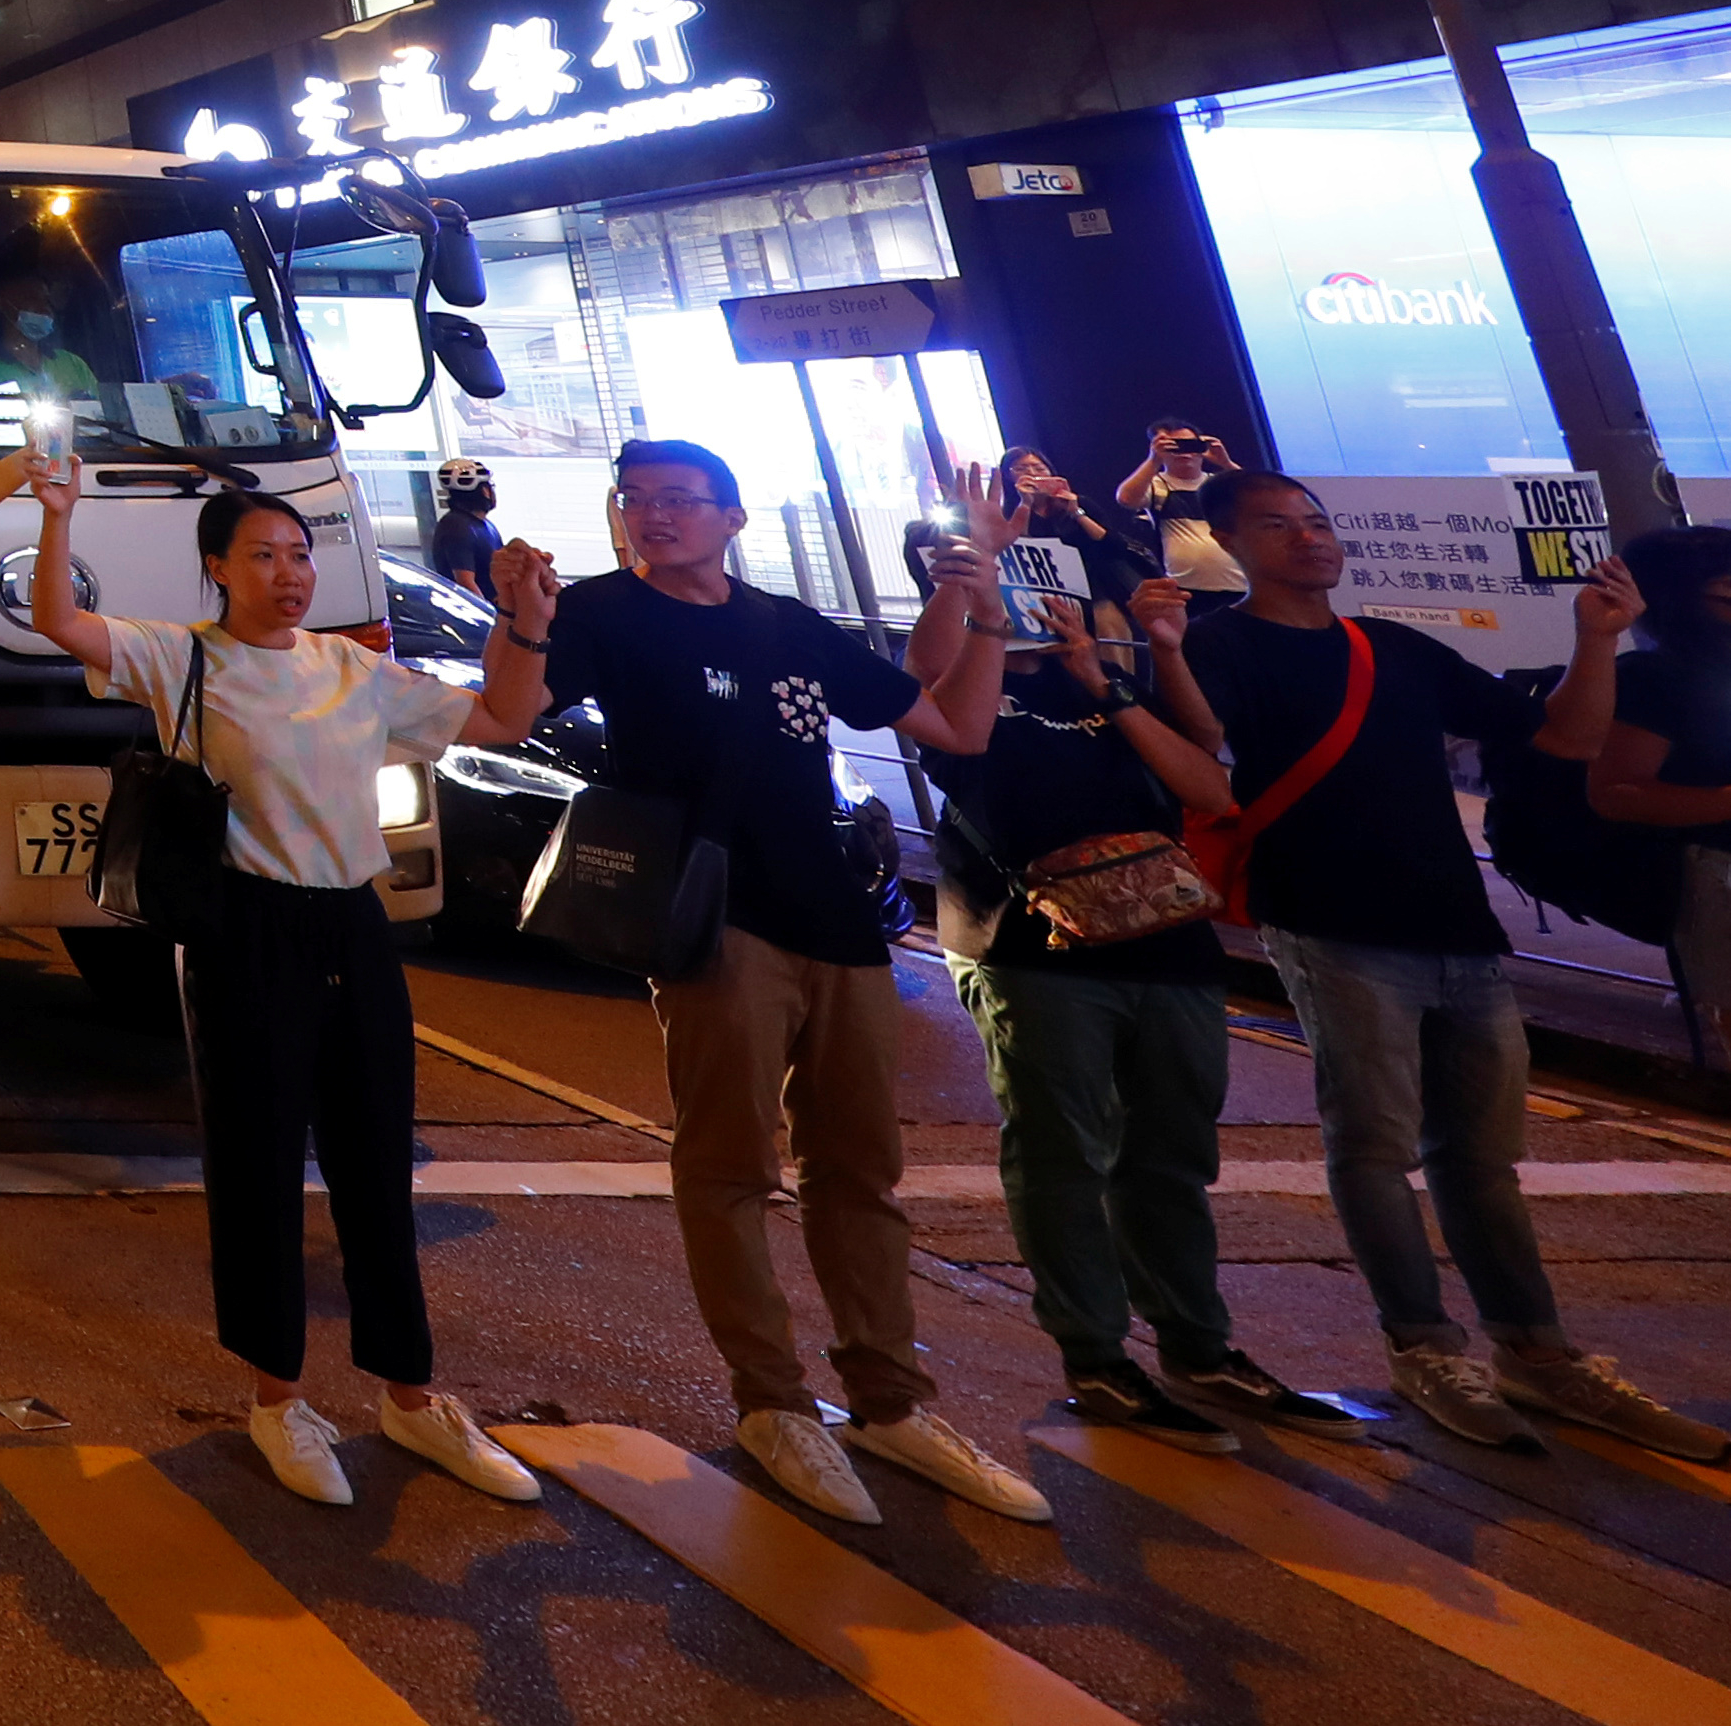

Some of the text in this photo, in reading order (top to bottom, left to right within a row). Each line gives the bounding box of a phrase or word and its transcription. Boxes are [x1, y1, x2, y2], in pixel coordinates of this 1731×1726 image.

[1012, 168, 1074, 191] Jetco
[1080, 211, 1097, 222] 20
[760, 295, 889, 322] Pedder Street
[1301, 276, 1499, 325] citibank
[998, 544, 1066, 590] HERE
[1527, 532, 1575, 578] WE
[1372, 608, 1450, 622] Bank in hand
[51, 803, 102, 838] SS
[575, 853, 635, 874] HEIDELBERG
[576, 843, 635, 863] UNIVERSITÄT
